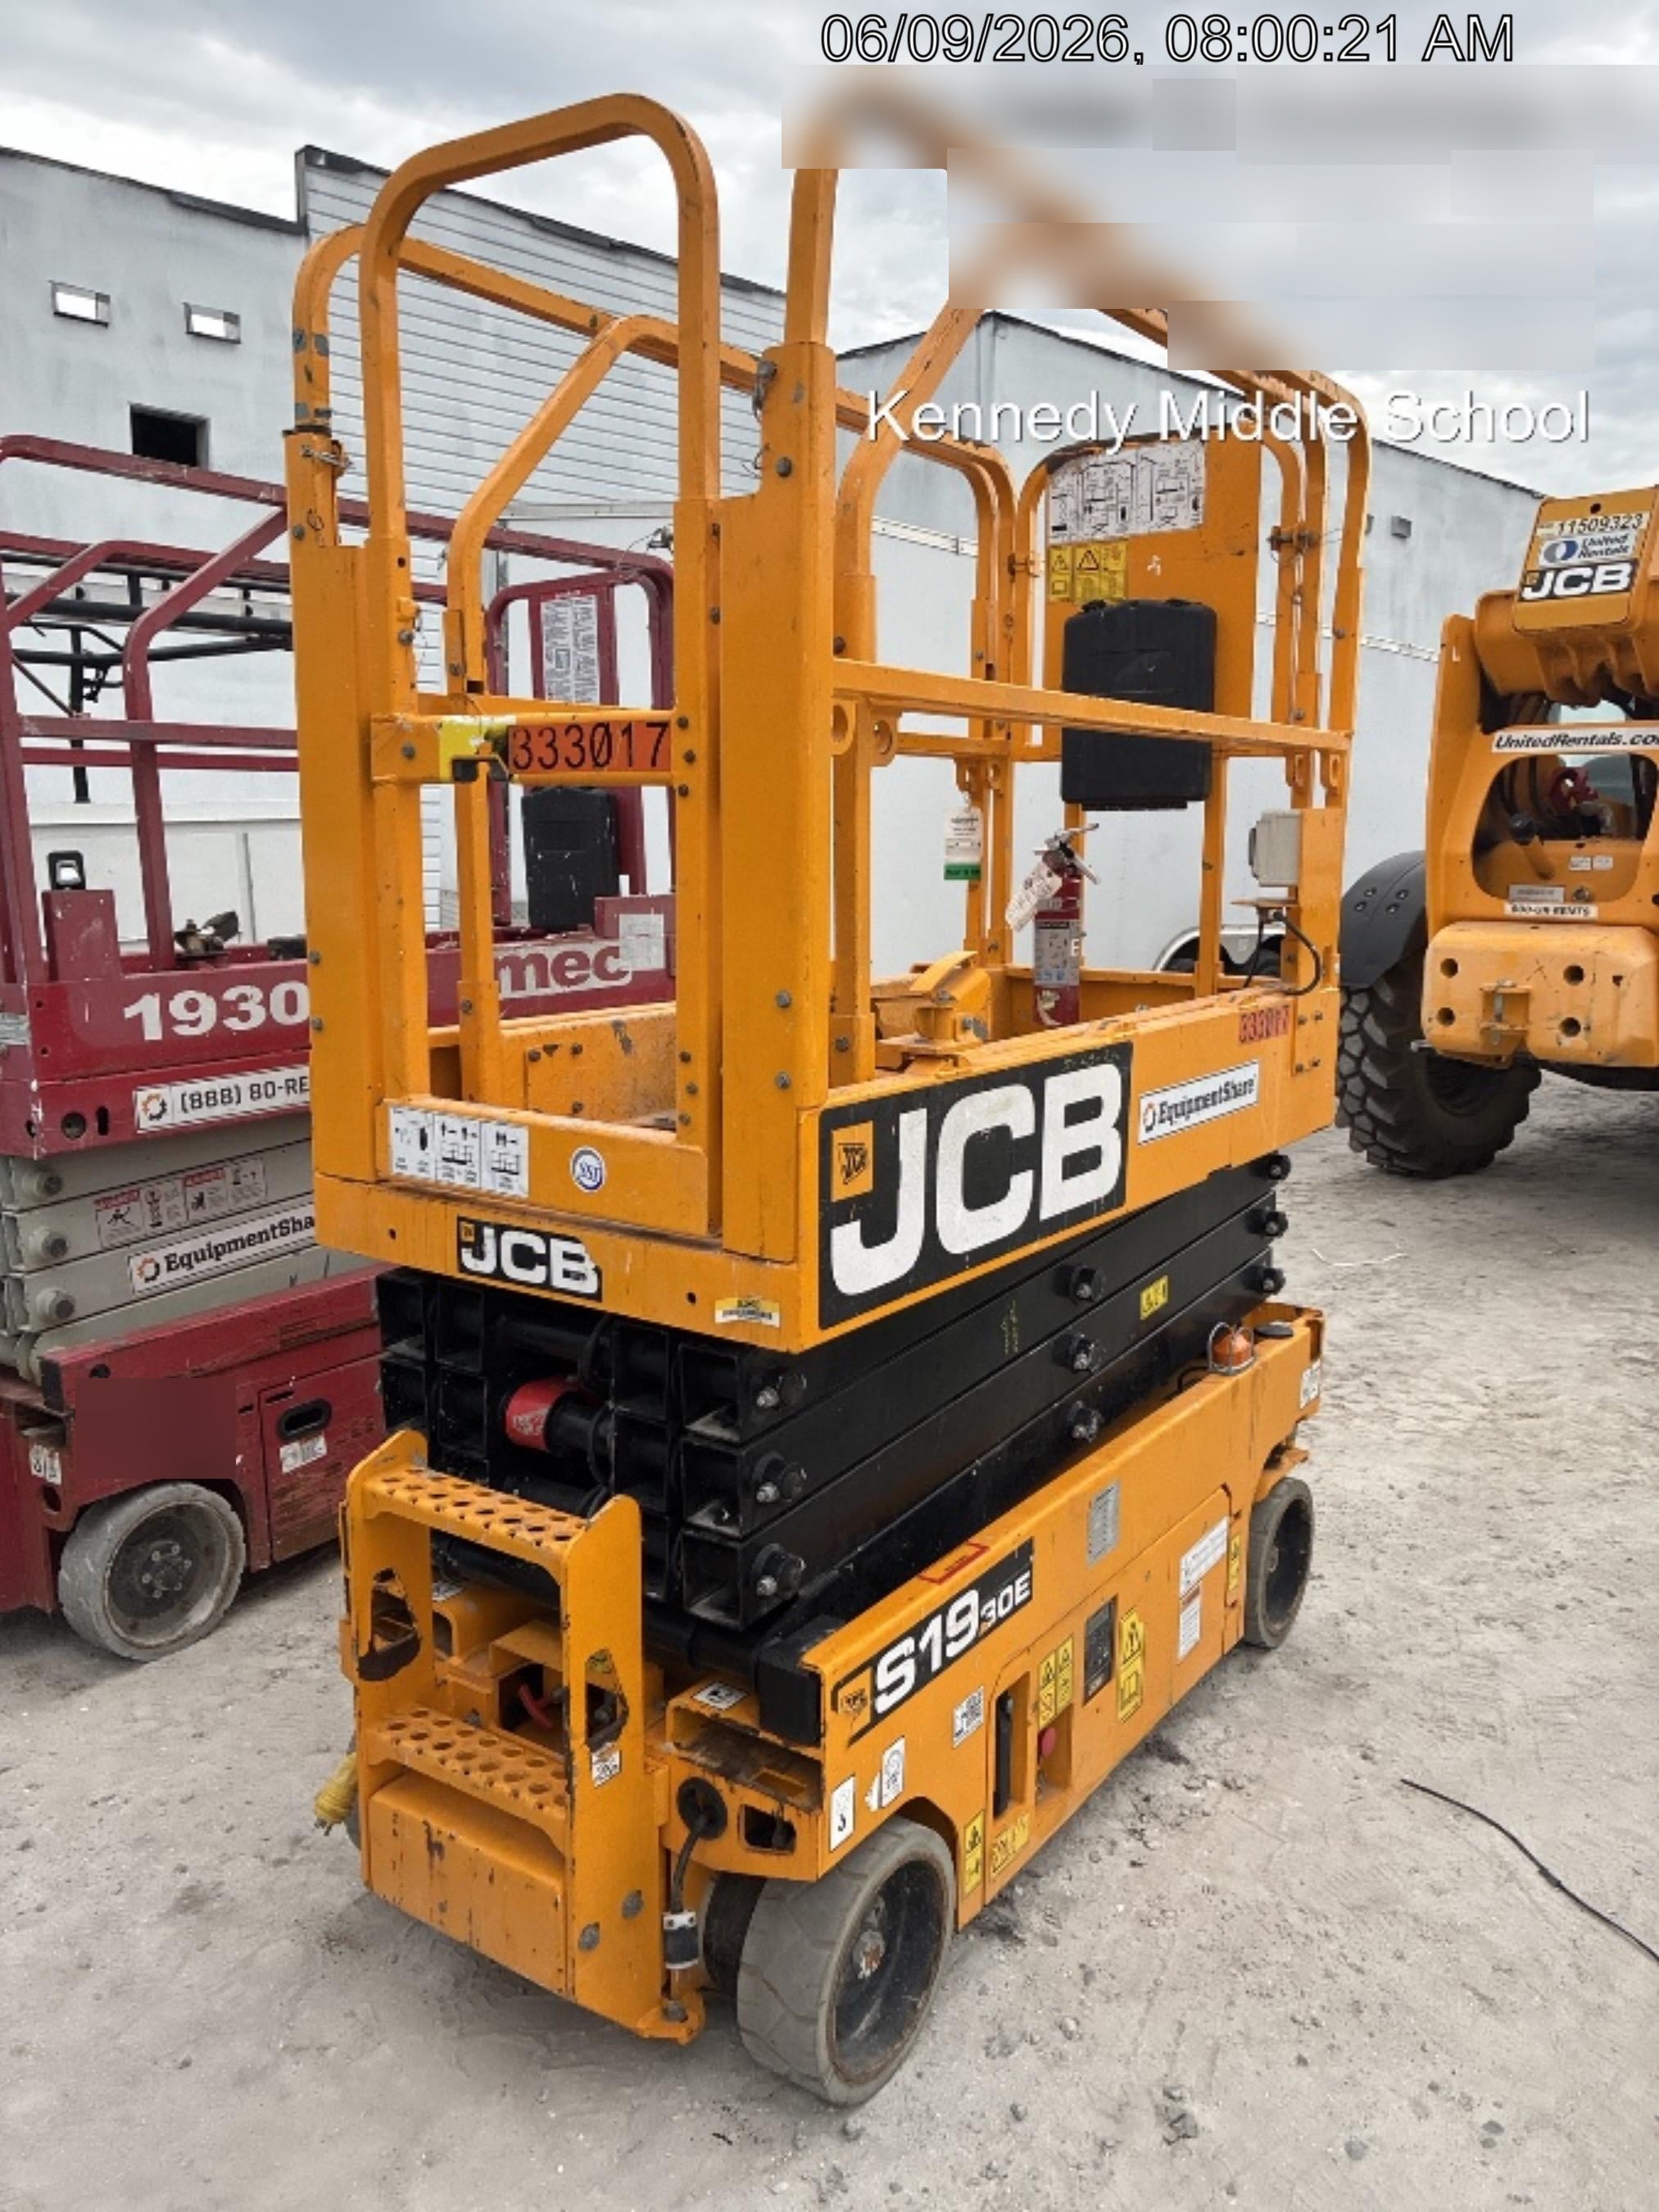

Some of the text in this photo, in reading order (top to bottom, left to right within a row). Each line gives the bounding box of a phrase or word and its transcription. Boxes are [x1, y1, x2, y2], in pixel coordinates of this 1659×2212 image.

[1558, 514, 1643, 535] 11509323
[1582, 533, 1630, 547] United
[1521, 562, 1631, 600] JCB
[512, 722, 670, 770] 333017
[1495, 732, 1659, 749] UnitedRentals.co
[124, 981, 310, 1041] 1930
[181, 1084, 242, 1113] (888)
[1158, 1077, 1254, 1126] EquipmentShare
[831, 1063, 1122, 1296] JCB
[461, 1226, 598, 1294] JCB
